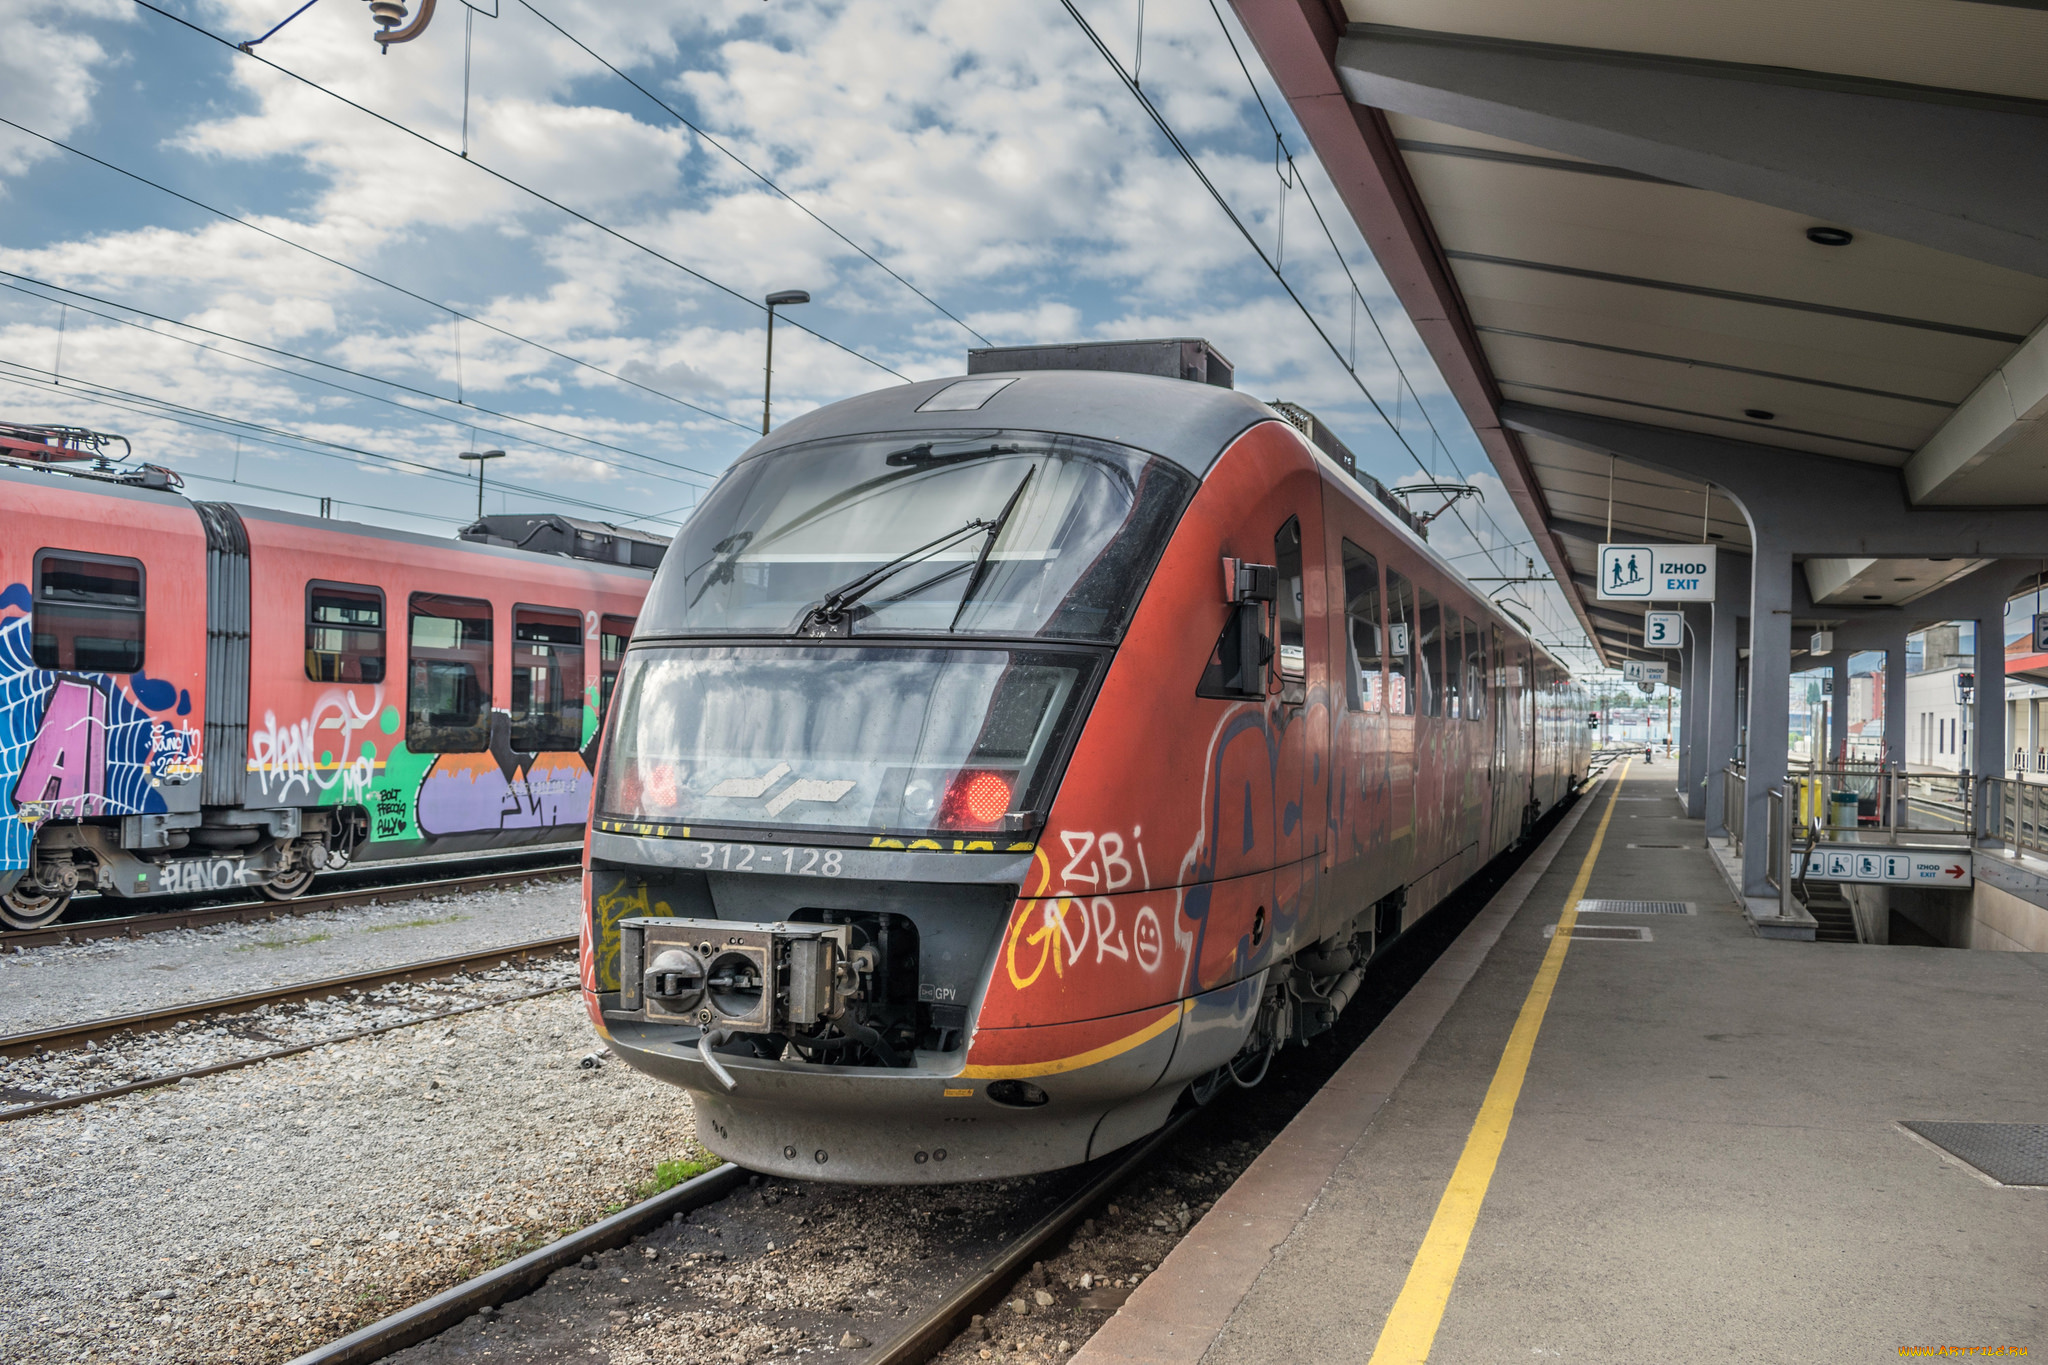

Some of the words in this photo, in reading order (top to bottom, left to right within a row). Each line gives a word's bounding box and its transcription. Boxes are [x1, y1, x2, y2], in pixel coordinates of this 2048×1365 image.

[1660, 563, 1707, 574] IZHOD
[1667, 579, 1699, 590] EXIT
[586, 610, 599, 640] 2
[1652, 623, 1665, 640] 3
[695, 842, 843, 878] 312-128
[1916, 863, 1940, 871] IZHOD
[935, 987, 956, 1000] GPV
